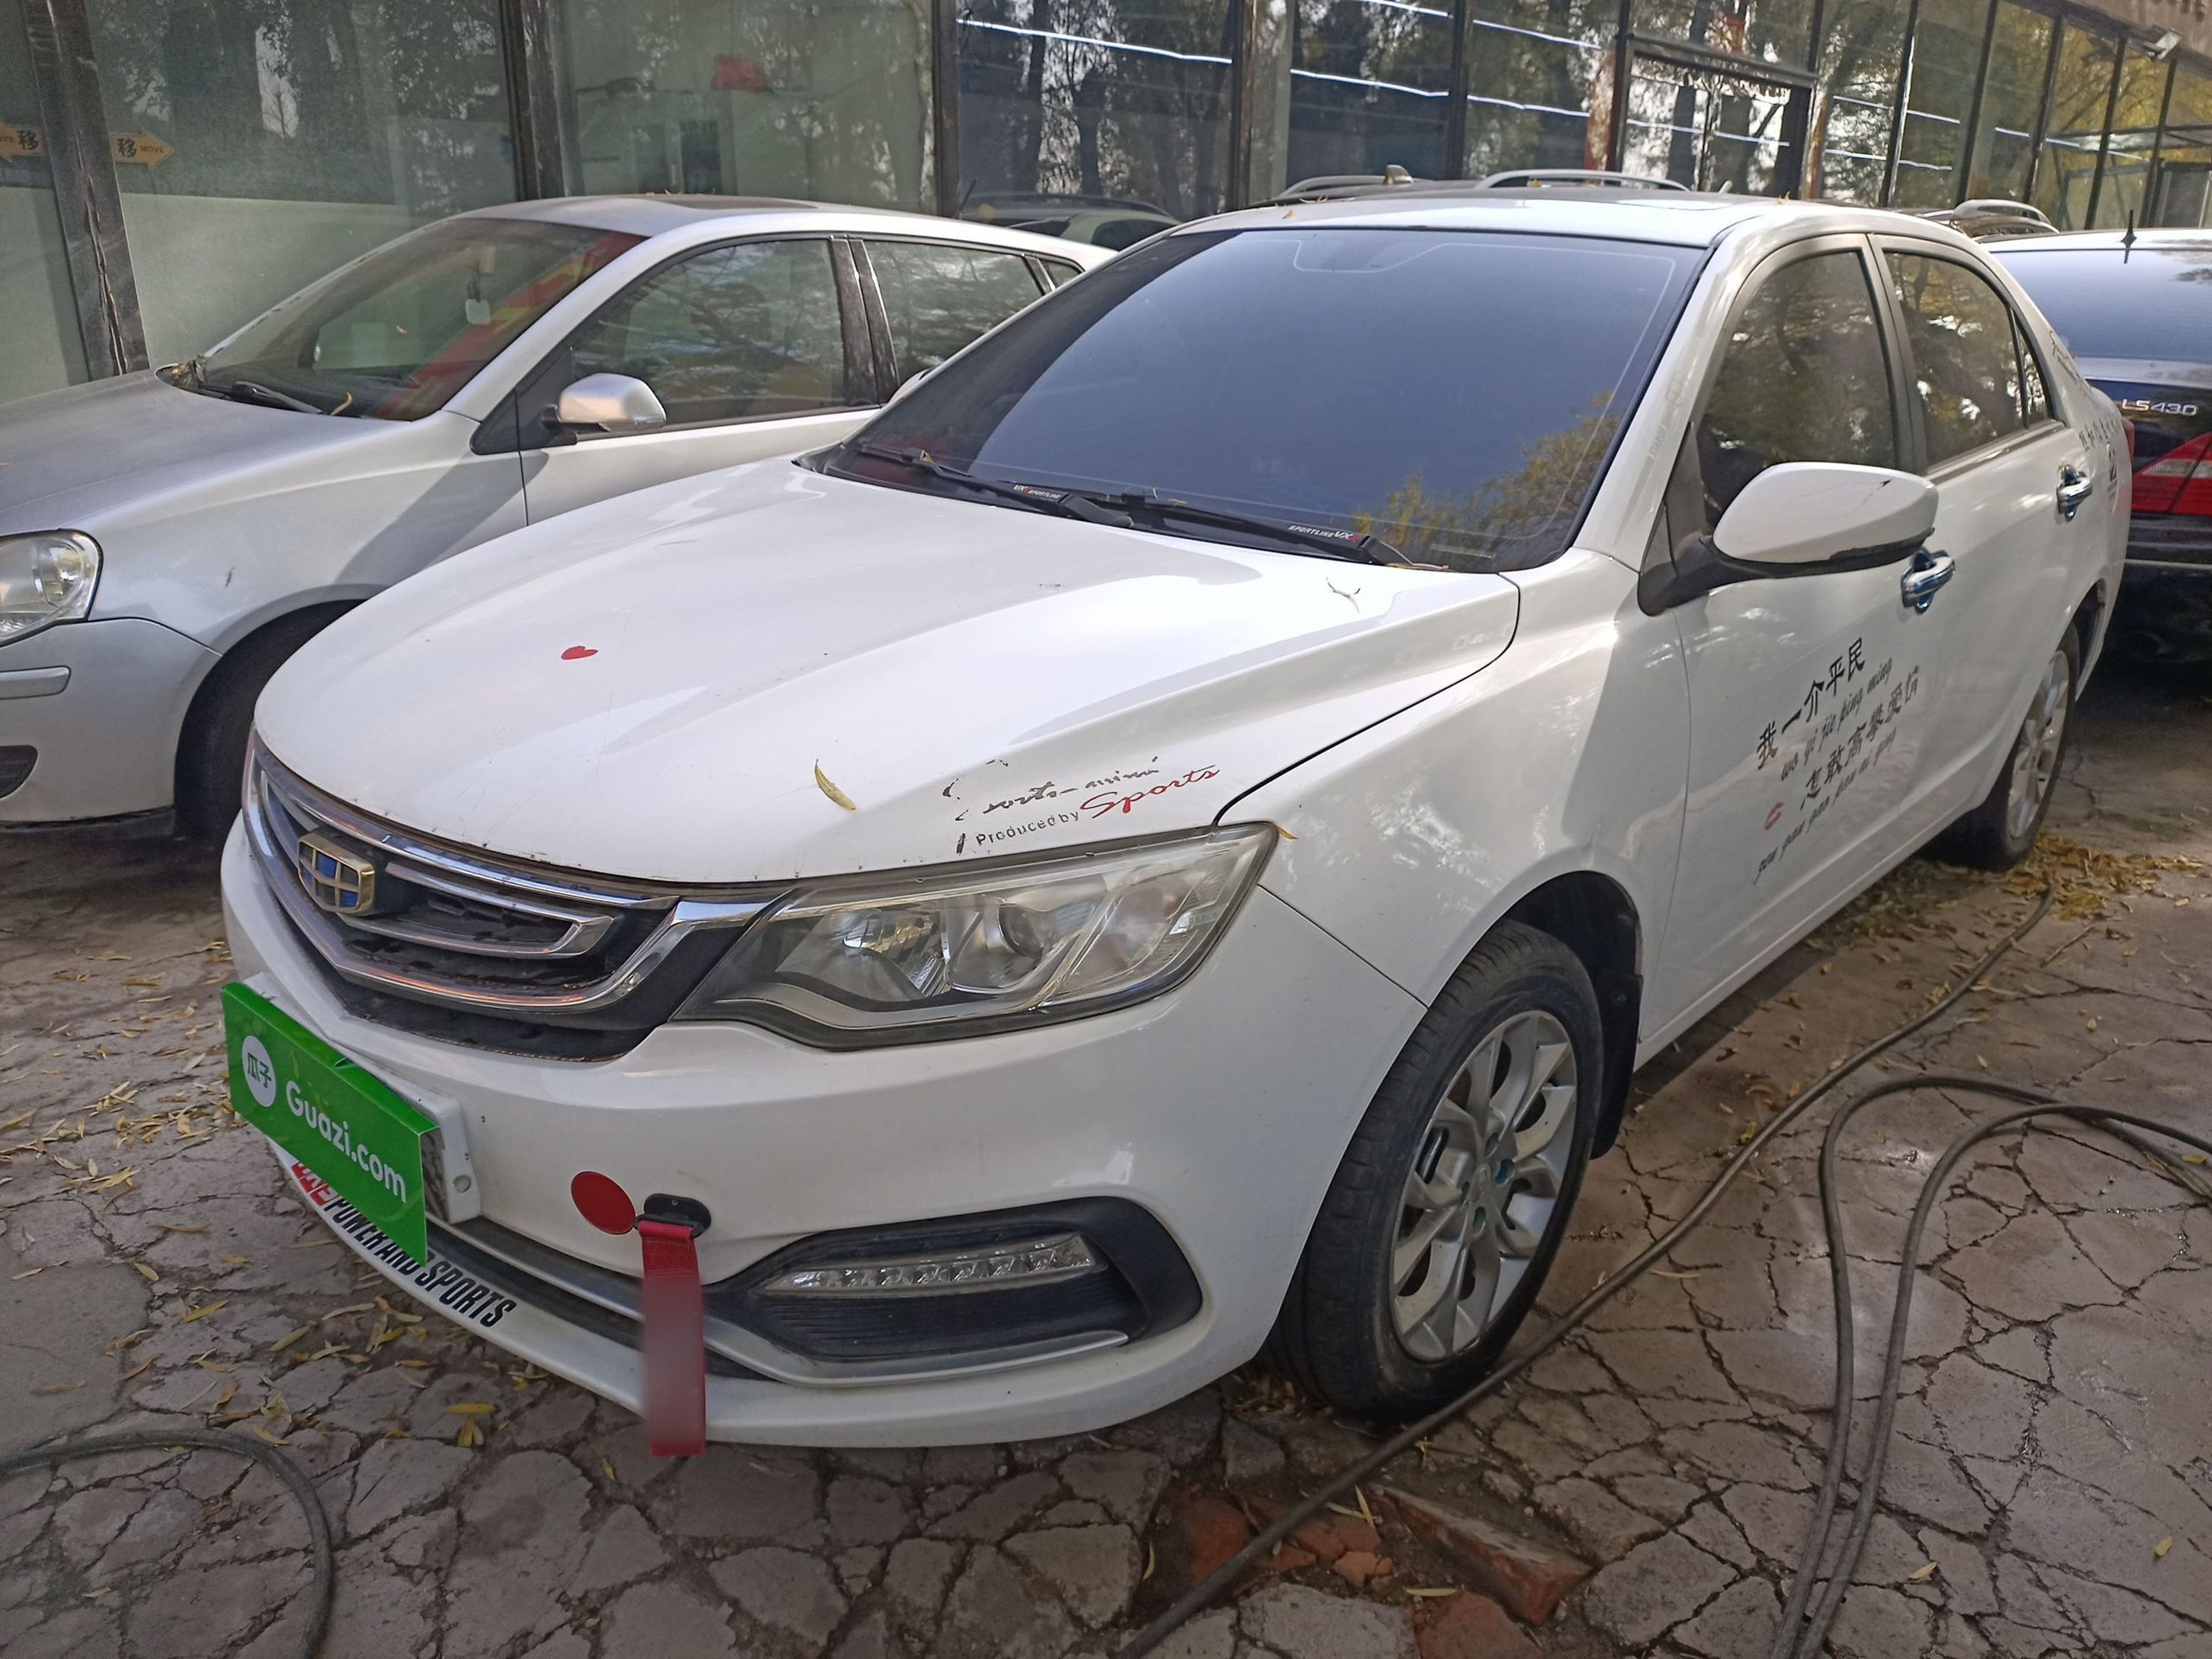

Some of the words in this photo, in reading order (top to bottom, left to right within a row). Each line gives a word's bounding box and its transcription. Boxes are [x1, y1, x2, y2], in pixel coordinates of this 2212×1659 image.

[17, 130, 39, 150] 移
[117, 138, 137, 157] 移
[2122, 399, 2198, 416] LS430
[1757, 637, 1865, 770] 我一介平民
[1080, 764, 1220, 819] Sports
[247, 1052, 272, 1088] 瓜子
[286, 1081, 407, 1203] Guazi.com
[414, 1260, 517, 1327] SPORTS
